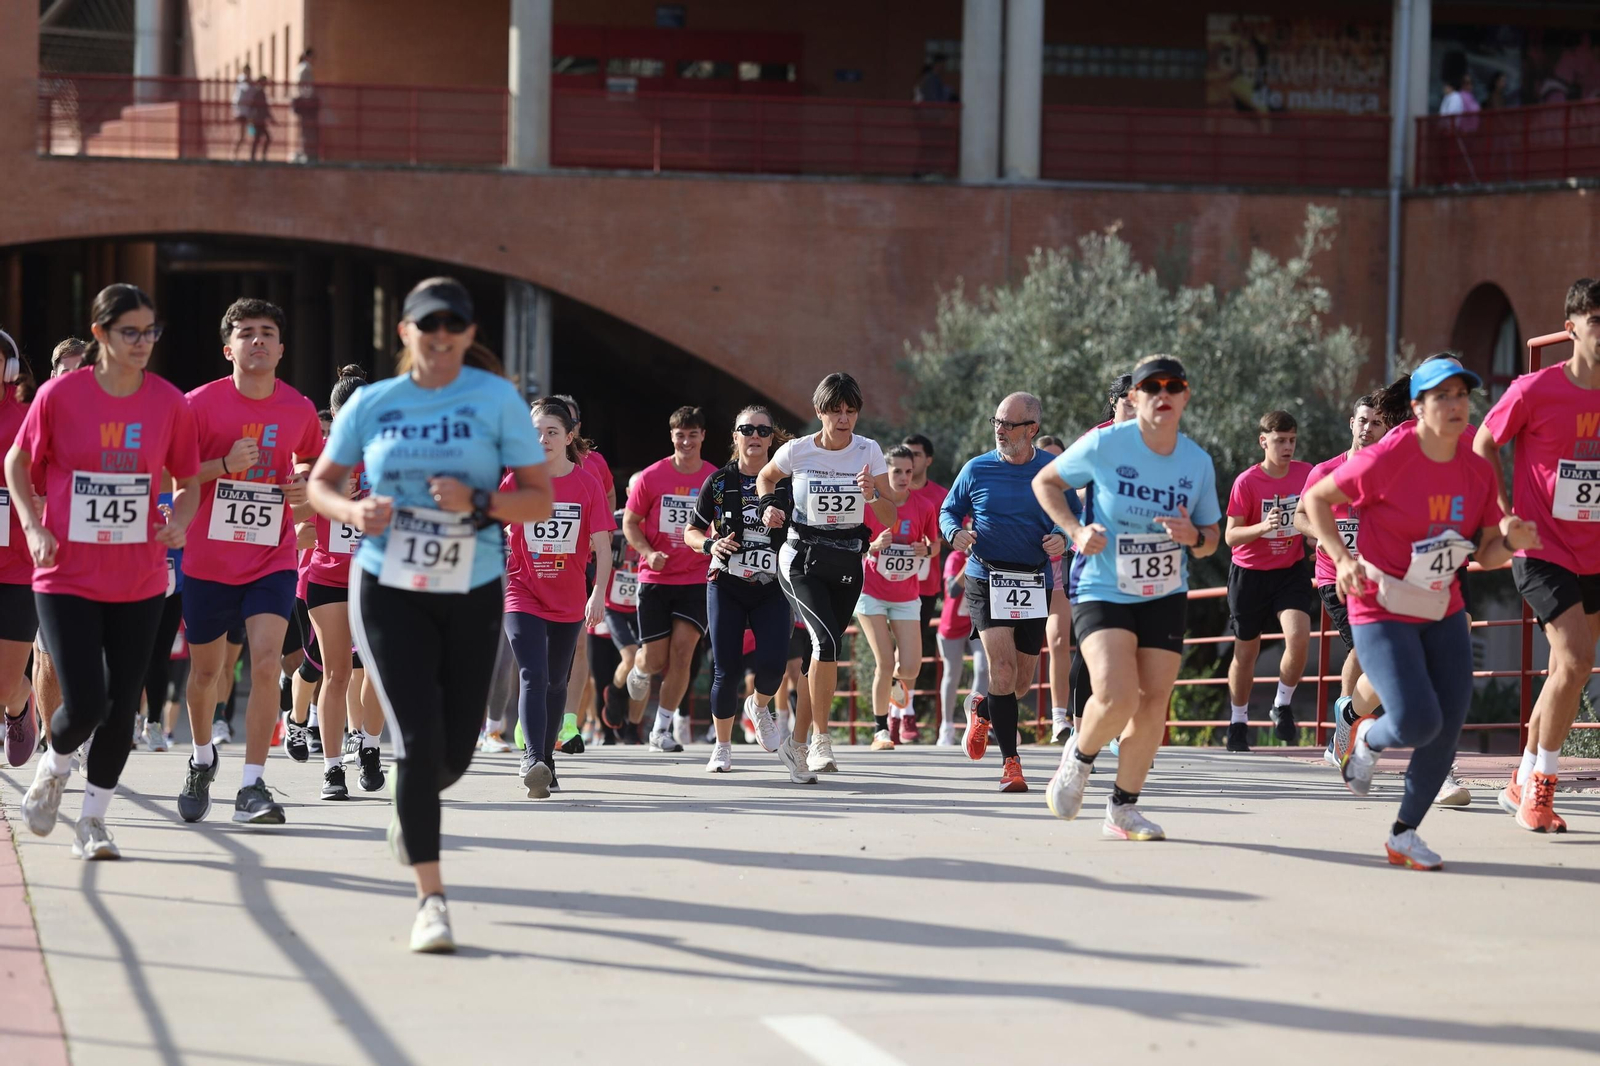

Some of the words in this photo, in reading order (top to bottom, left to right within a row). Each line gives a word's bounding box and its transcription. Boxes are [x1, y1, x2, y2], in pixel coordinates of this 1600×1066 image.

[1288, 88, 1379, 114] málaga
[380, 416, 471, 444] nerja
[1576, 412, 1600, 437] W
[100, 422, 142, 448] WE
[103, 452, 137, 471] RUN
[1562, 470, 1592, 479] UMA
[77, 484, 110, 495] UMA
[218, 489, 249, 501] UMA
[811, 485, 835, 493] UMA
[1117, 480, 1188, 511] nerja
[86, 499, 137, 523] 145
[817, 495, 856, 512] 532
[1428, 495, 1464, 522] WE
[225, 503, 272, 527] 165
[533, 521, 573, 539] 637
[401, 537, 462, 567] 194
[882, 548, 901, 556] UMA
[1120, 544, 1152, 554] UMA
[738, 550, 771, 569] 116
[885, 557, 914, 571] 603
[1131, 555, 1173, 579] 183
[1430, 549, 1455, 574] 41
[993, 579, 1017, 587] UMA
[1006, 589, 1032, 606] 42
